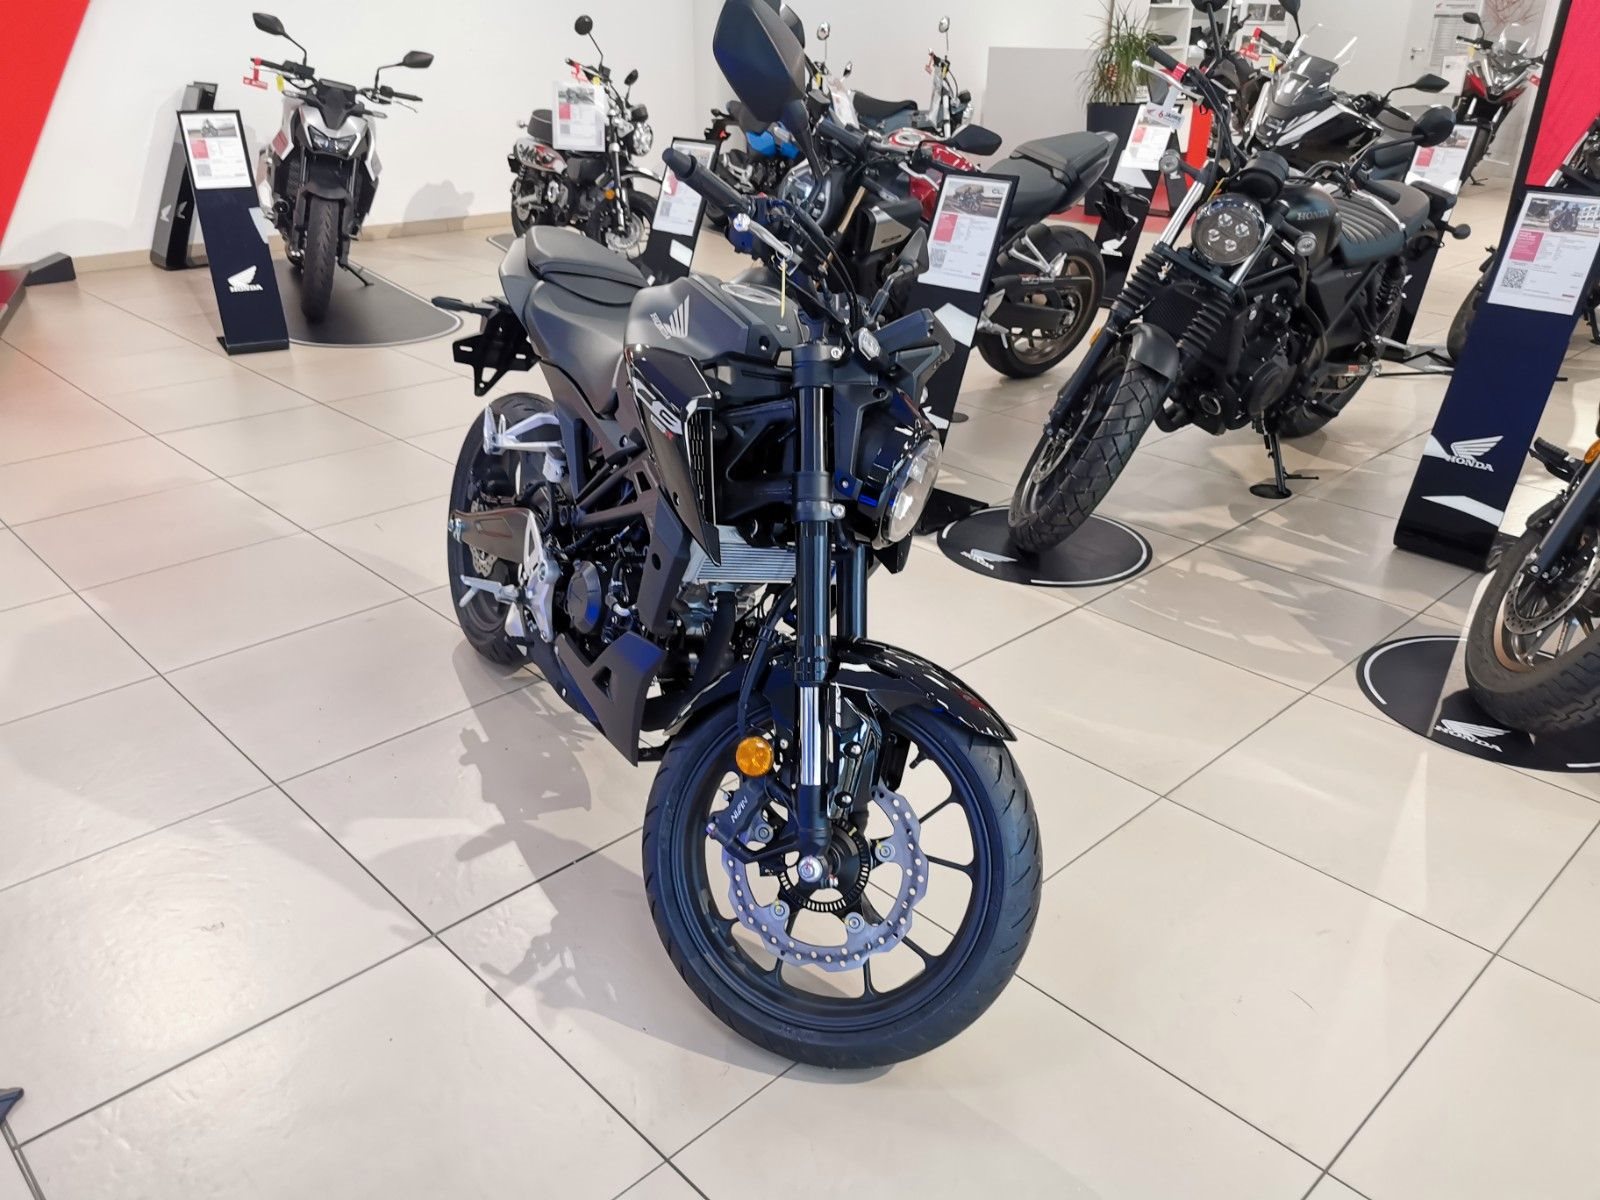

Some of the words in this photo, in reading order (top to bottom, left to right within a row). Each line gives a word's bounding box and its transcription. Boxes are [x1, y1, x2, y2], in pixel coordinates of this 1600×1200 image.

[1297, 208, 1330, 221] HONDA
[228, 283, 264, 293] HONDA
[650, 311, 672, 340] HONDA
[1445, 454, 1495, 473] HONDA
[1434, 724, 1504, 753] HONDA
